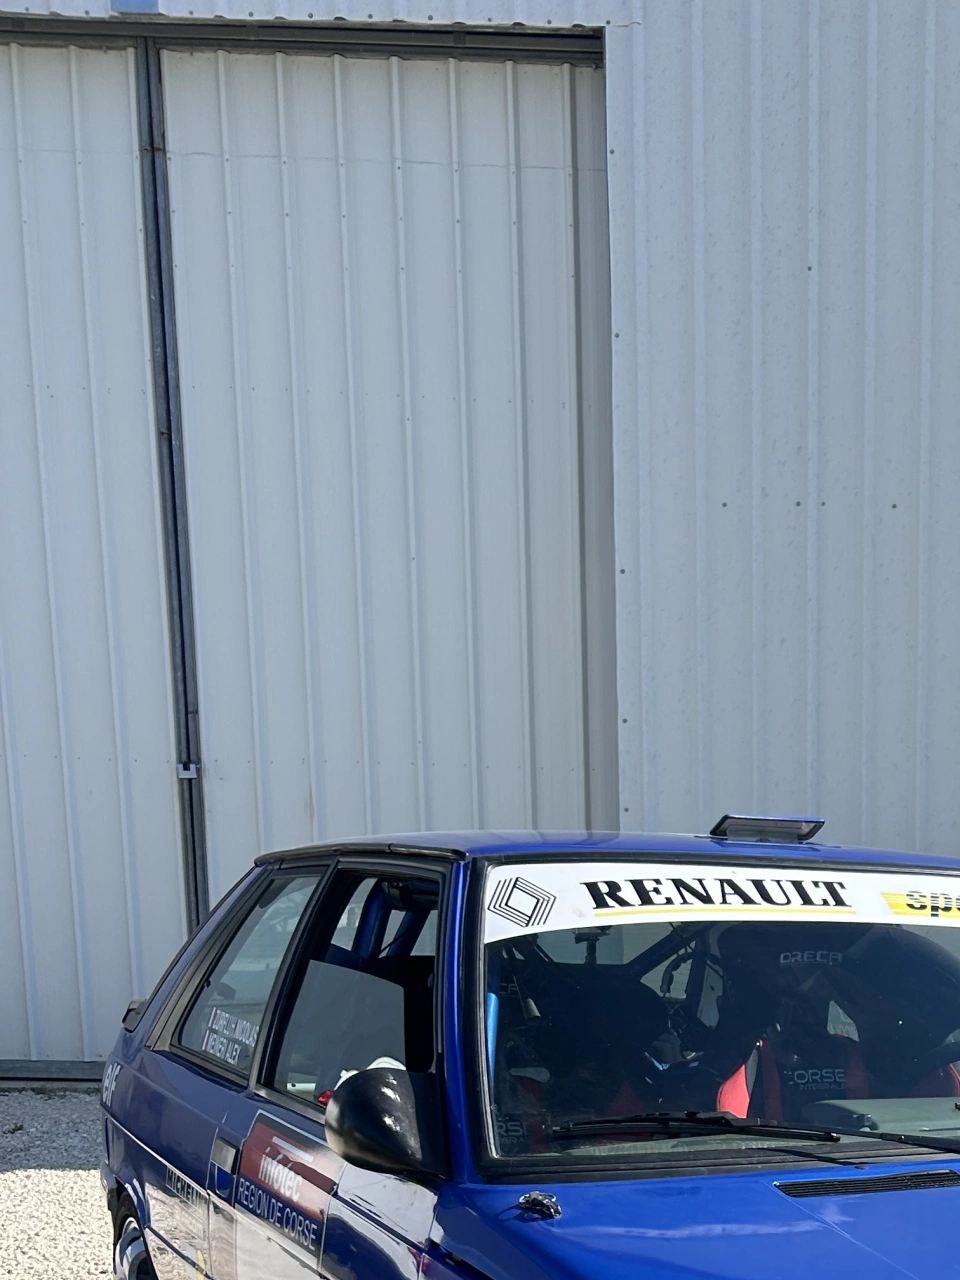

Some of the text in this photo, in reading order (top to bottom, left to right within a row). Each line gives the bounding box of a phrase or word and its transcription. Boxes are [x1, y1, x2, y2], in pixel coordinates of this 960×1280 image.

[580, 878, 852, 909] RENAULT
[788, 1069, 845, 1083] ORSE
[237, 1178, 318, 1251] REGION DE CORSE
